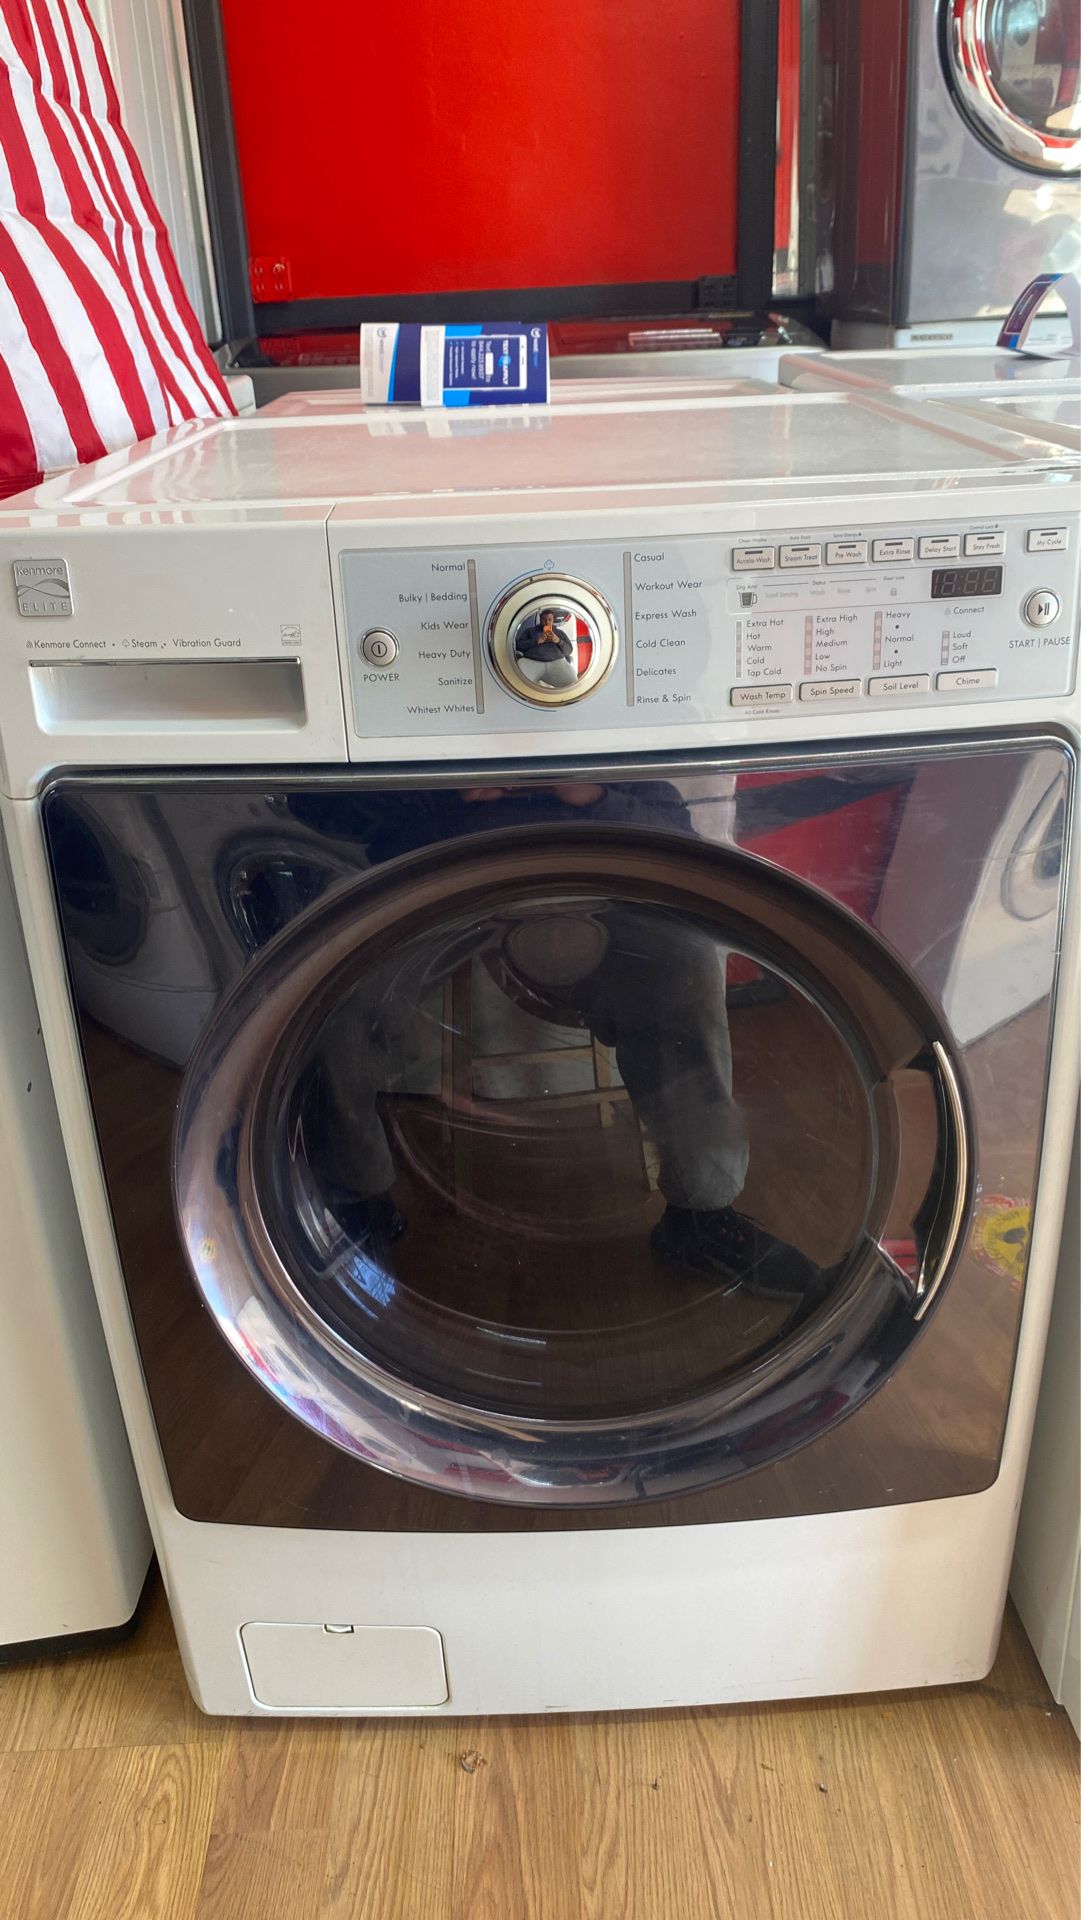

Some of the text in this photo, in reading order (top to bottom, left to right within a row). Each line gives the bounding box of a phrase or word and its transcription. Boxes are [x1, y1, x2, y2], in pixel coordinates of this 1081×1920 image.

[634, 552, 665, 563] Casual
[16, 565, 63, 576] Kenmore
[431, 562, 466, 572] Normal
[635, 580, 702, 592] Workout Wear
[398, 591, 467, 604] Bulky Bedding
[22, 602, 68, 612] ELITE
[953, 606, 984, 614] Connect
[635, 609, 697, 622] Express Wash
[840, 614, 857, 623] High
[886, 611, 910, 619] Heavy
[421, 621, 469, 631] Kids Wear
[816, 628, 834, 637] High
[34, 638, 241, 649] Kenmore Connect Steam Vibration Guard
[636, 638, 686, 649] Cold Clean
[1009, 637, 1070, 649] START PAUSE
[418, 649, 470, 661] Heavy Duty
[831, 664, 847, 672] Spin
[884, 660, 902, 668] Light
[636, 667, 677, 677] Delicates
[747, 669, 760, 677] Tap
[363, 673, 400, 683] POWER
[438, 676, 473, 686] Sanitize
[956, 677, 980, 686] Chime
[766, 692, 786, 700] Temp
[810, 686, 854, 696] Spin Speed
[637, 693, 692, 704] Rinse & Spin
[407, 704, 475, 715] Whitest Whites
